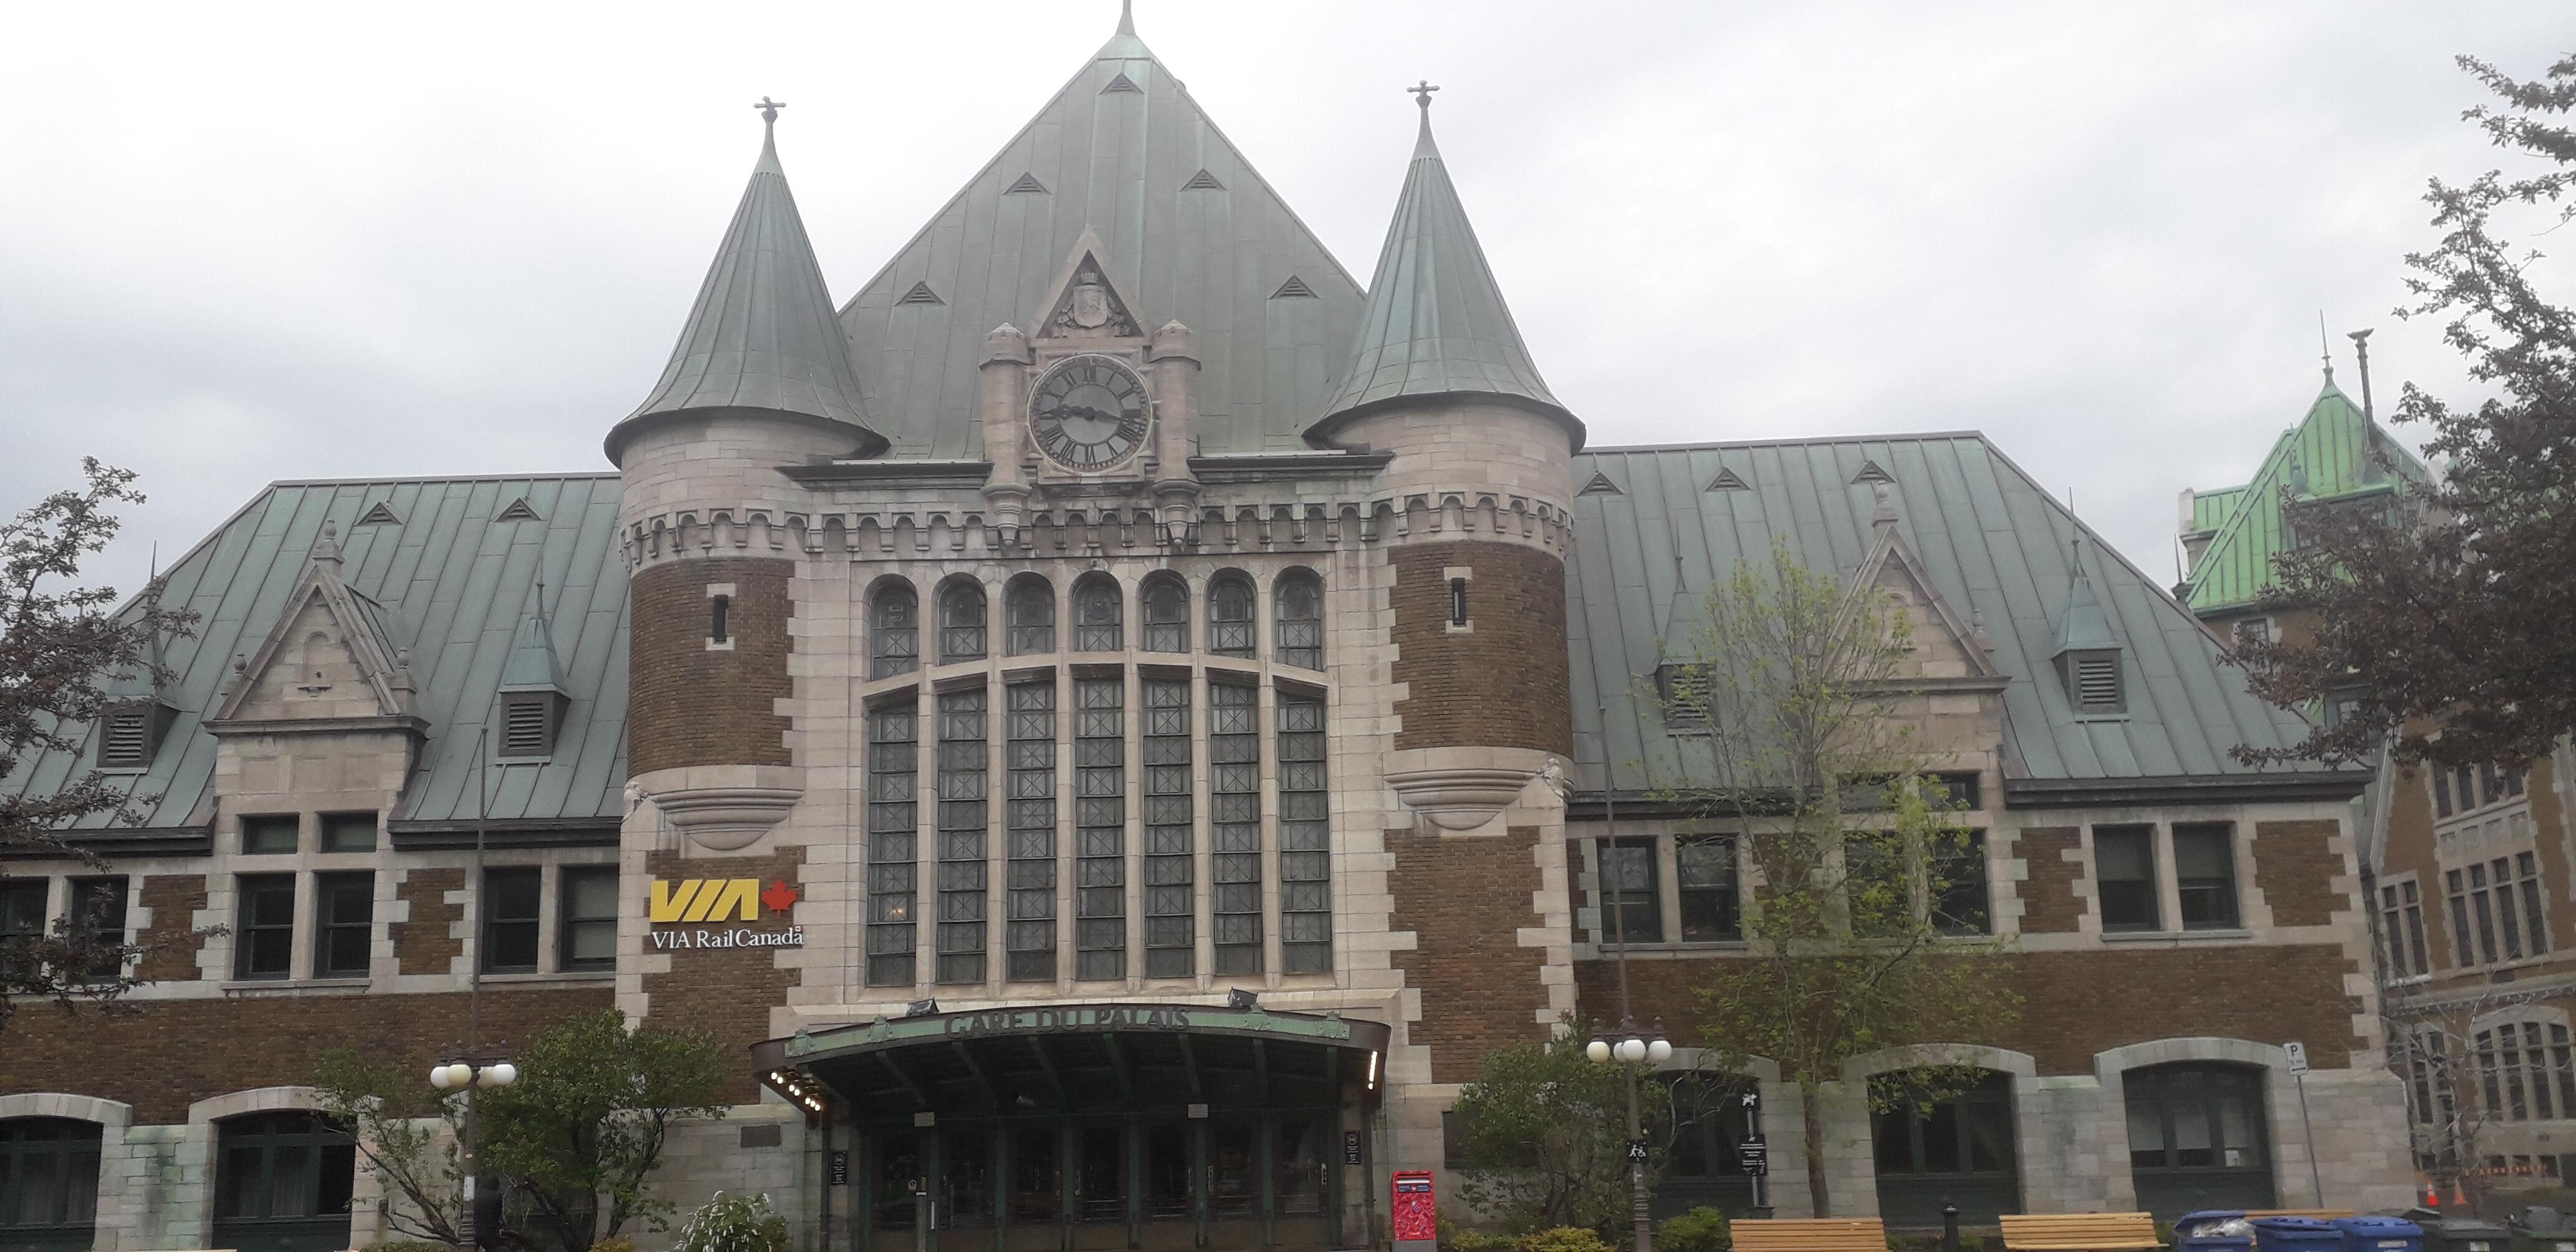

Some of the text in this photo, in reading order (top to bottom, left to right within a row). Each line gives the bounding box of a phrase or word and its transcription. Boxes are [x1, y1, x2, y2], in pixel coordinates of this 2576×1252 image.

[650, 879, 759, 922] VIA
[651, 931, 691, 949] VIA
[944, 1005, 1190, 1039] GARE DU PALAIS
[2290, 1045, 2298, 1057] P
